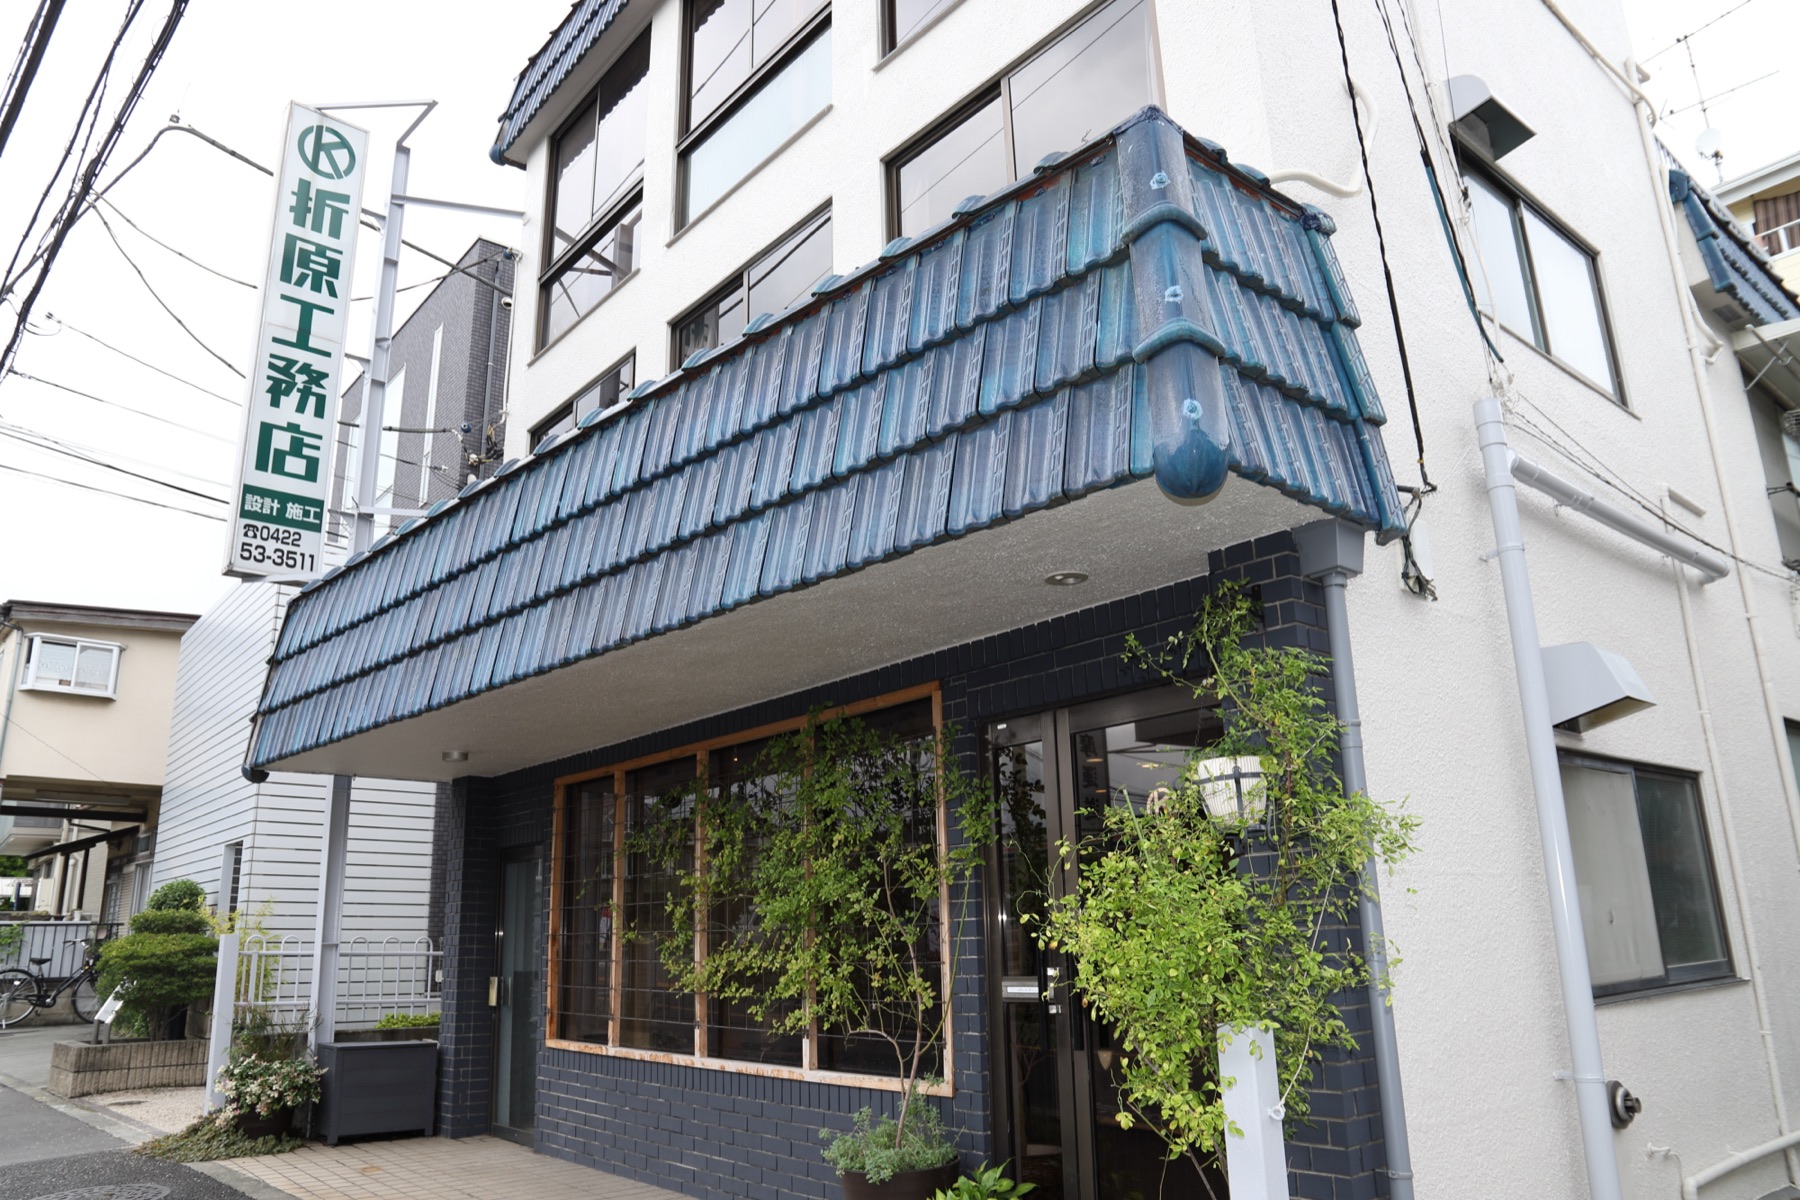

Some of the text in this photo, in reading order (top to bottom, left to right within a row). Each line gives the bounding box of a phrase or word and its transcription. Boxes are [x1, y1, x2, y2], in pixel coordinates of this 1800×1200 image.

[256, 178, 350, 483] 折原工務店
[244, 494, 321, 524] 設計 施工
[240, 543, 315, 571] 53-3511
